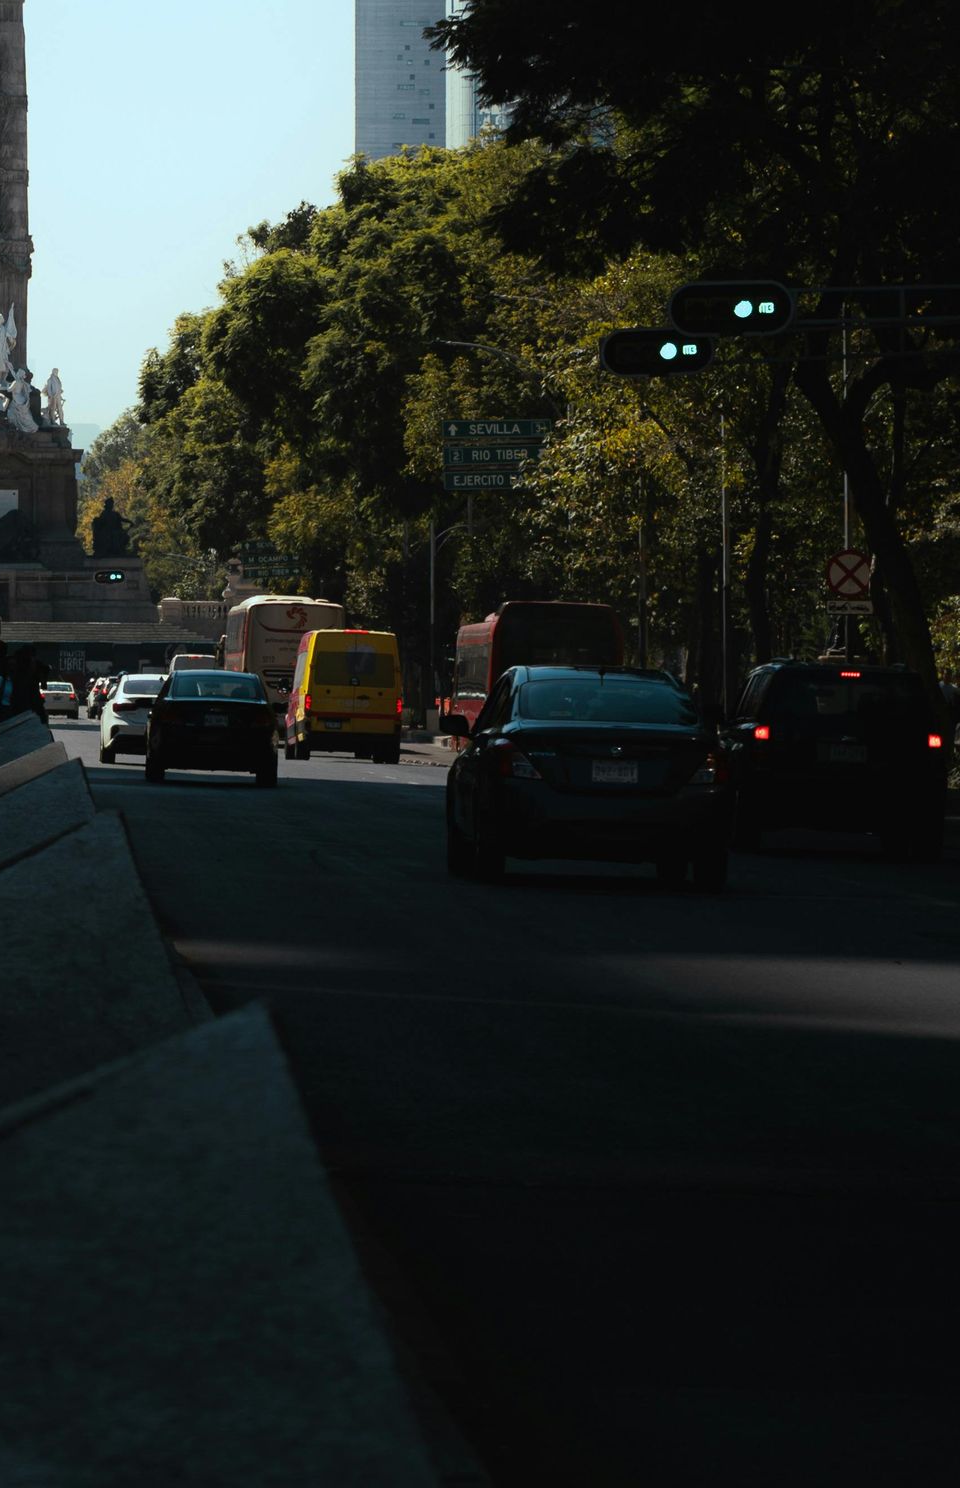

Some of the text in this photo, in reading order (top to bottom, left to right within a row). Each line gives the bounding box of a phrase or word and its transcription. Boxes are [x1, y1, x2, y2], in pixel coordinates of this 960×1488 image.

[468, 423, 521, 435] SEVILLA
[471, 450, 491, 461] RIO
[495, 448, 529, 460] TIBER
[453, 475, 504, 487] EJERCITO
